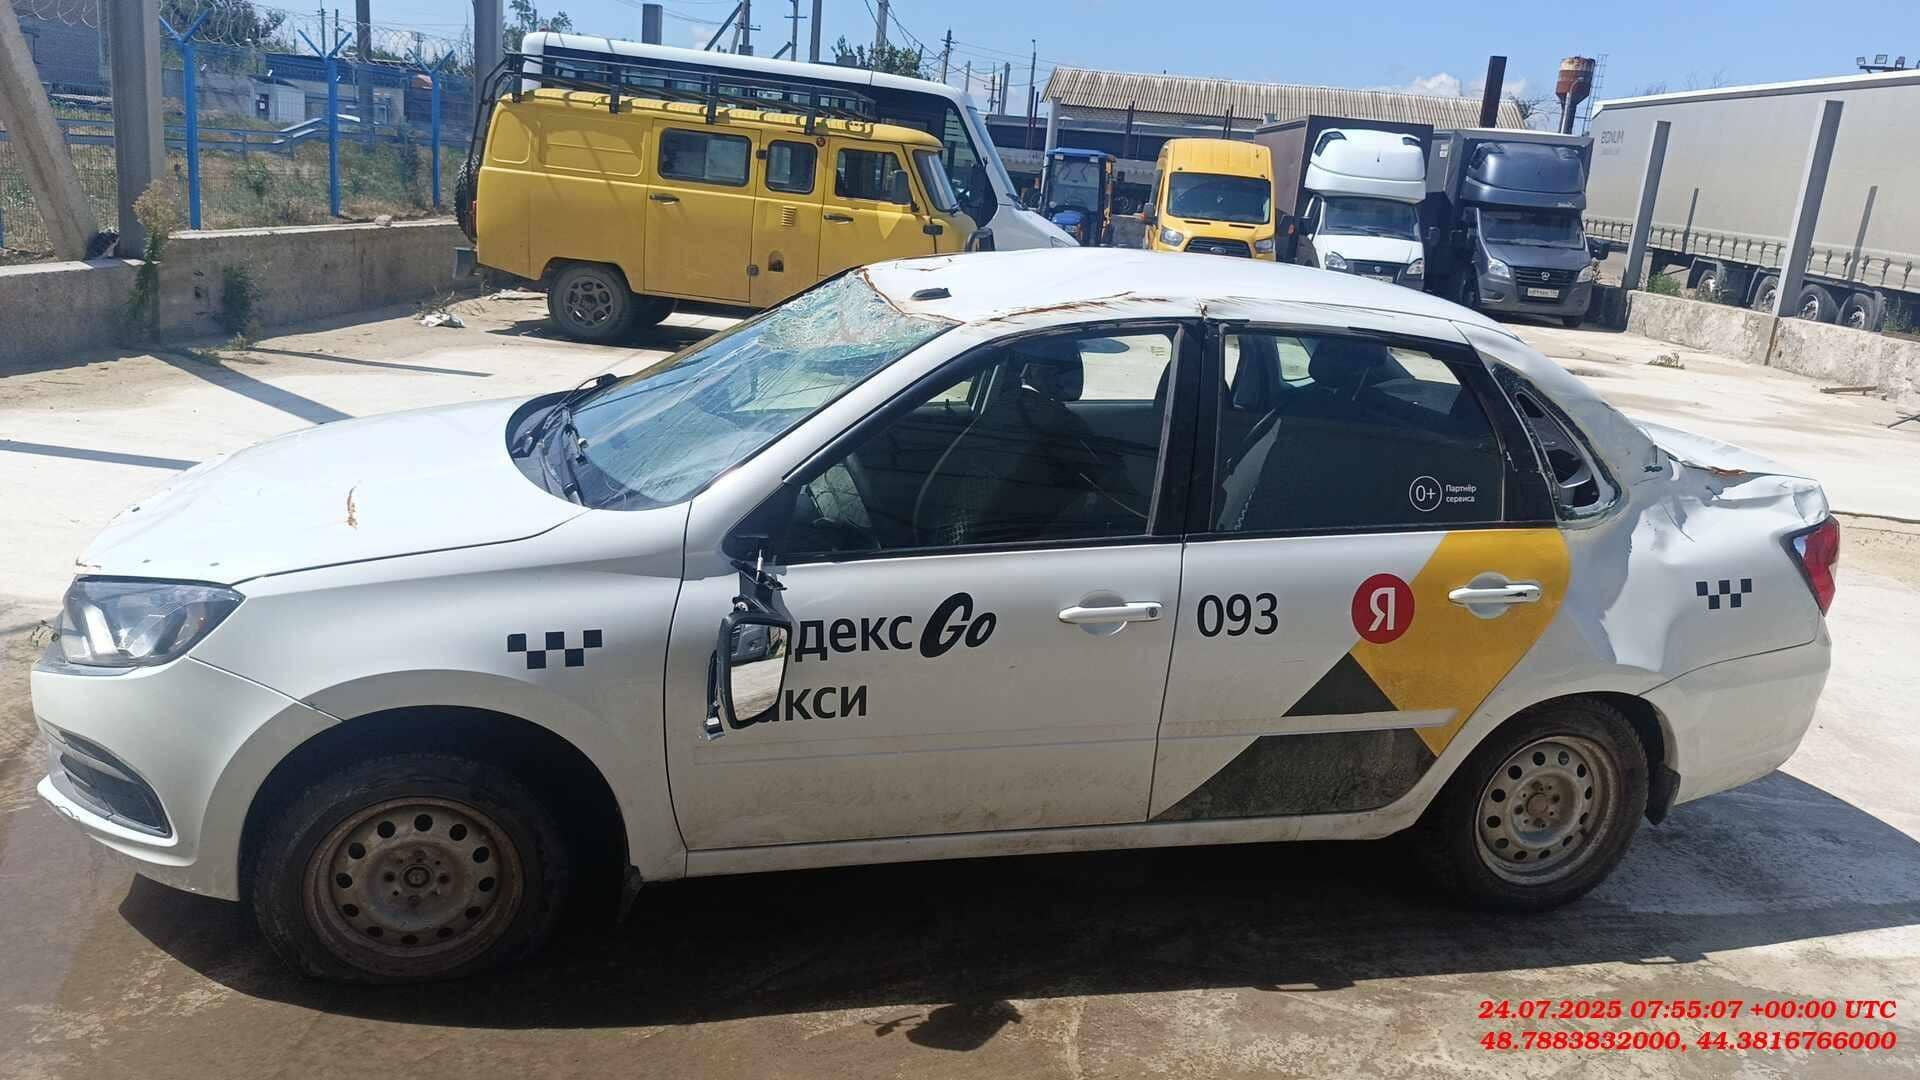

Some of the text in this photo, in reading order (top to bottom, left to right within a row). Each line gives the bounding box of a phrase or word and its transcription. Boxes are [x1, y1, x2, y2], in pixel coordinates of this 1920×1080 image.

[1416, 485, 1437, 502] 0+
[1445, 484, 1477, 494] Партнёр
[785, 591, 998, 663] декс Go
[1196, 592, 1280, 638] 093
[1368, 586, 1396, 632] Я
[758, 684, 868, 723] кси
